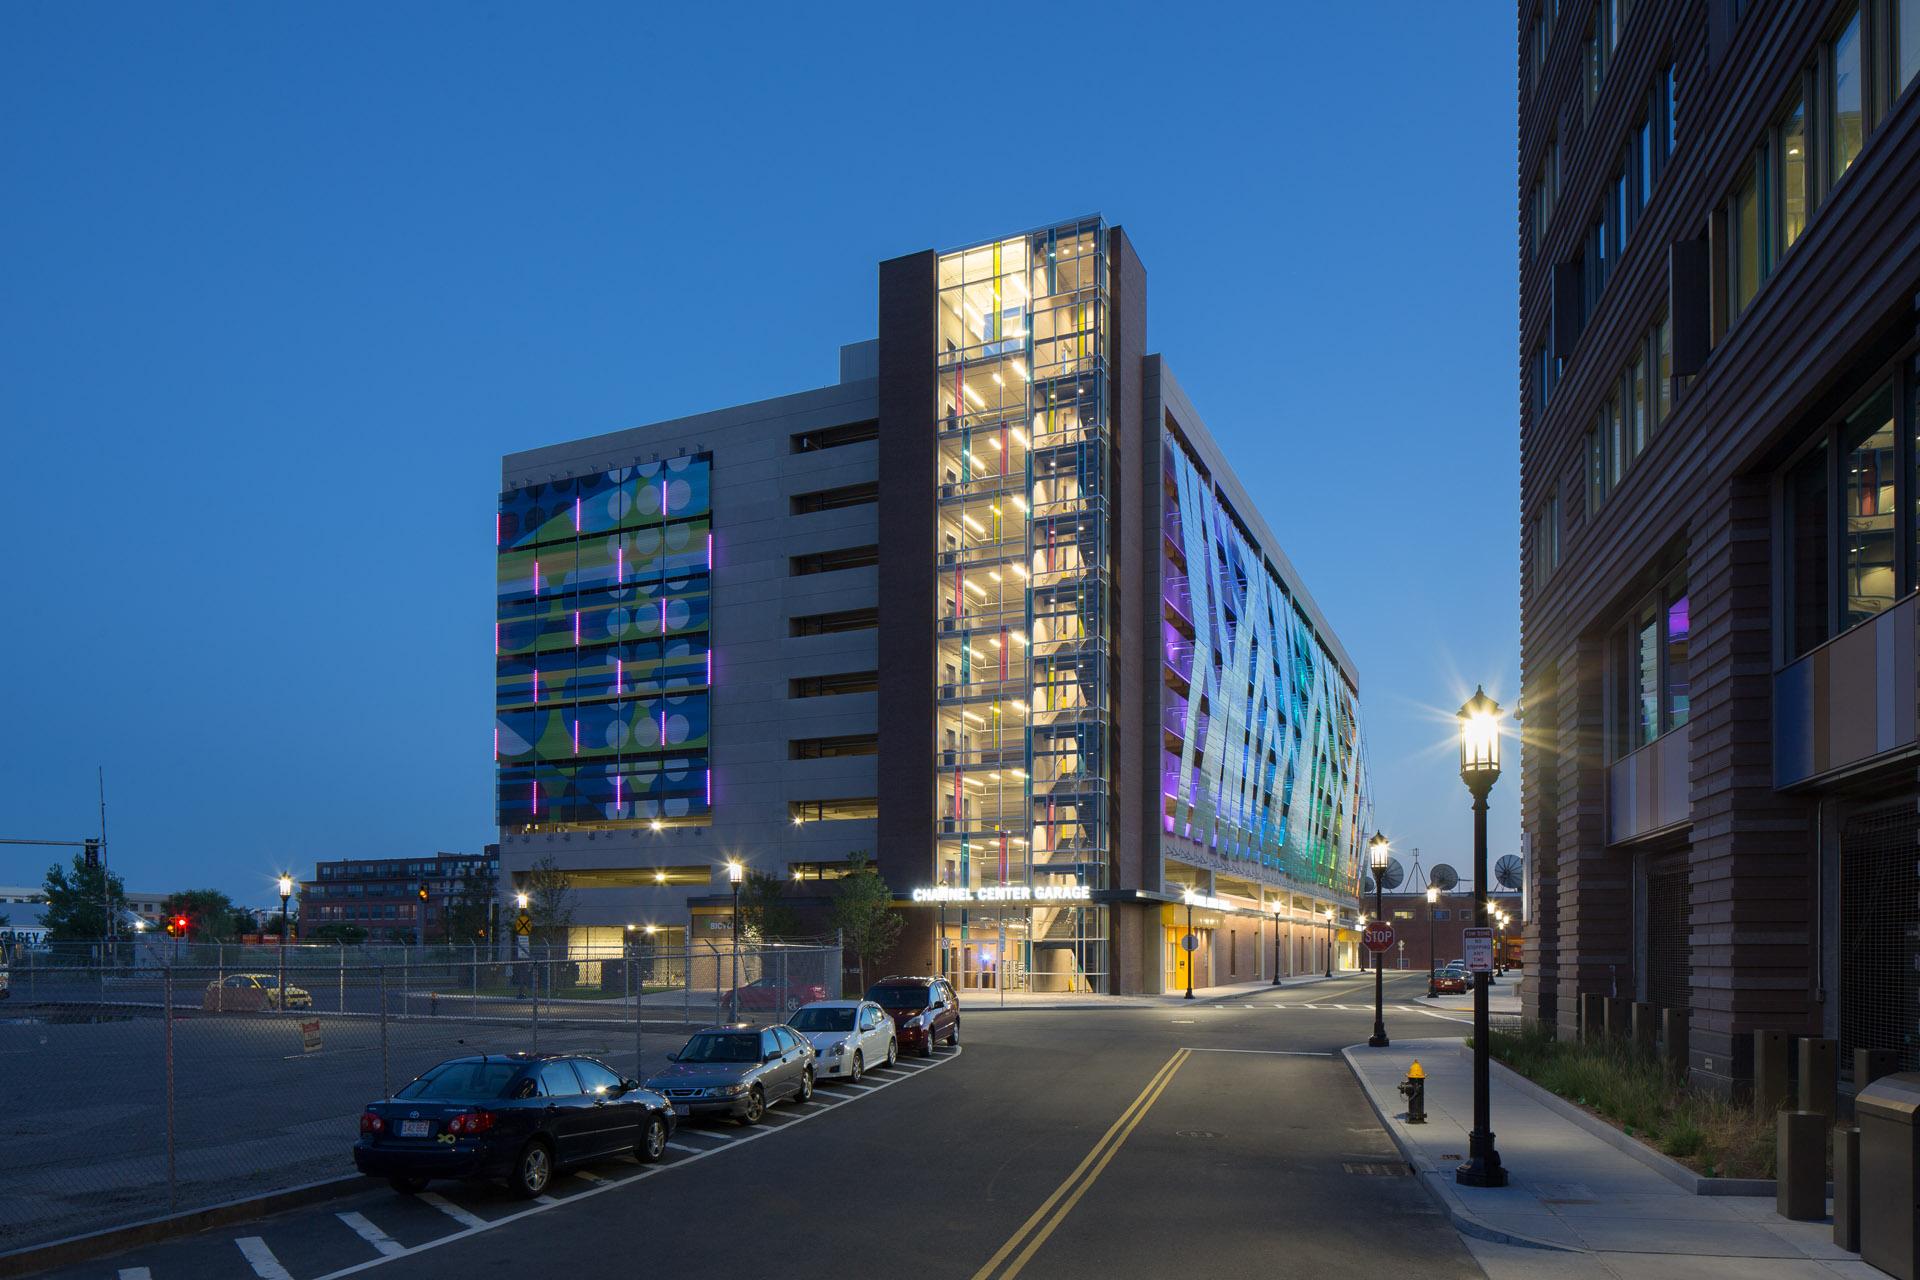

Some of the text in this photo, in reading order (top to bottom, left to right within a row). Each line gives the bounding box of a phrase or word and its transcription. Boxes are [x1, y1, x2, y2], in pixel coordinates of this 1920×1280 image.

[913, 886, 1090, 901] CHANNEL CENTER GARAGE
[1, 931, 39, 944] CASEY
[1365, 930, 1393, 943] STOP
